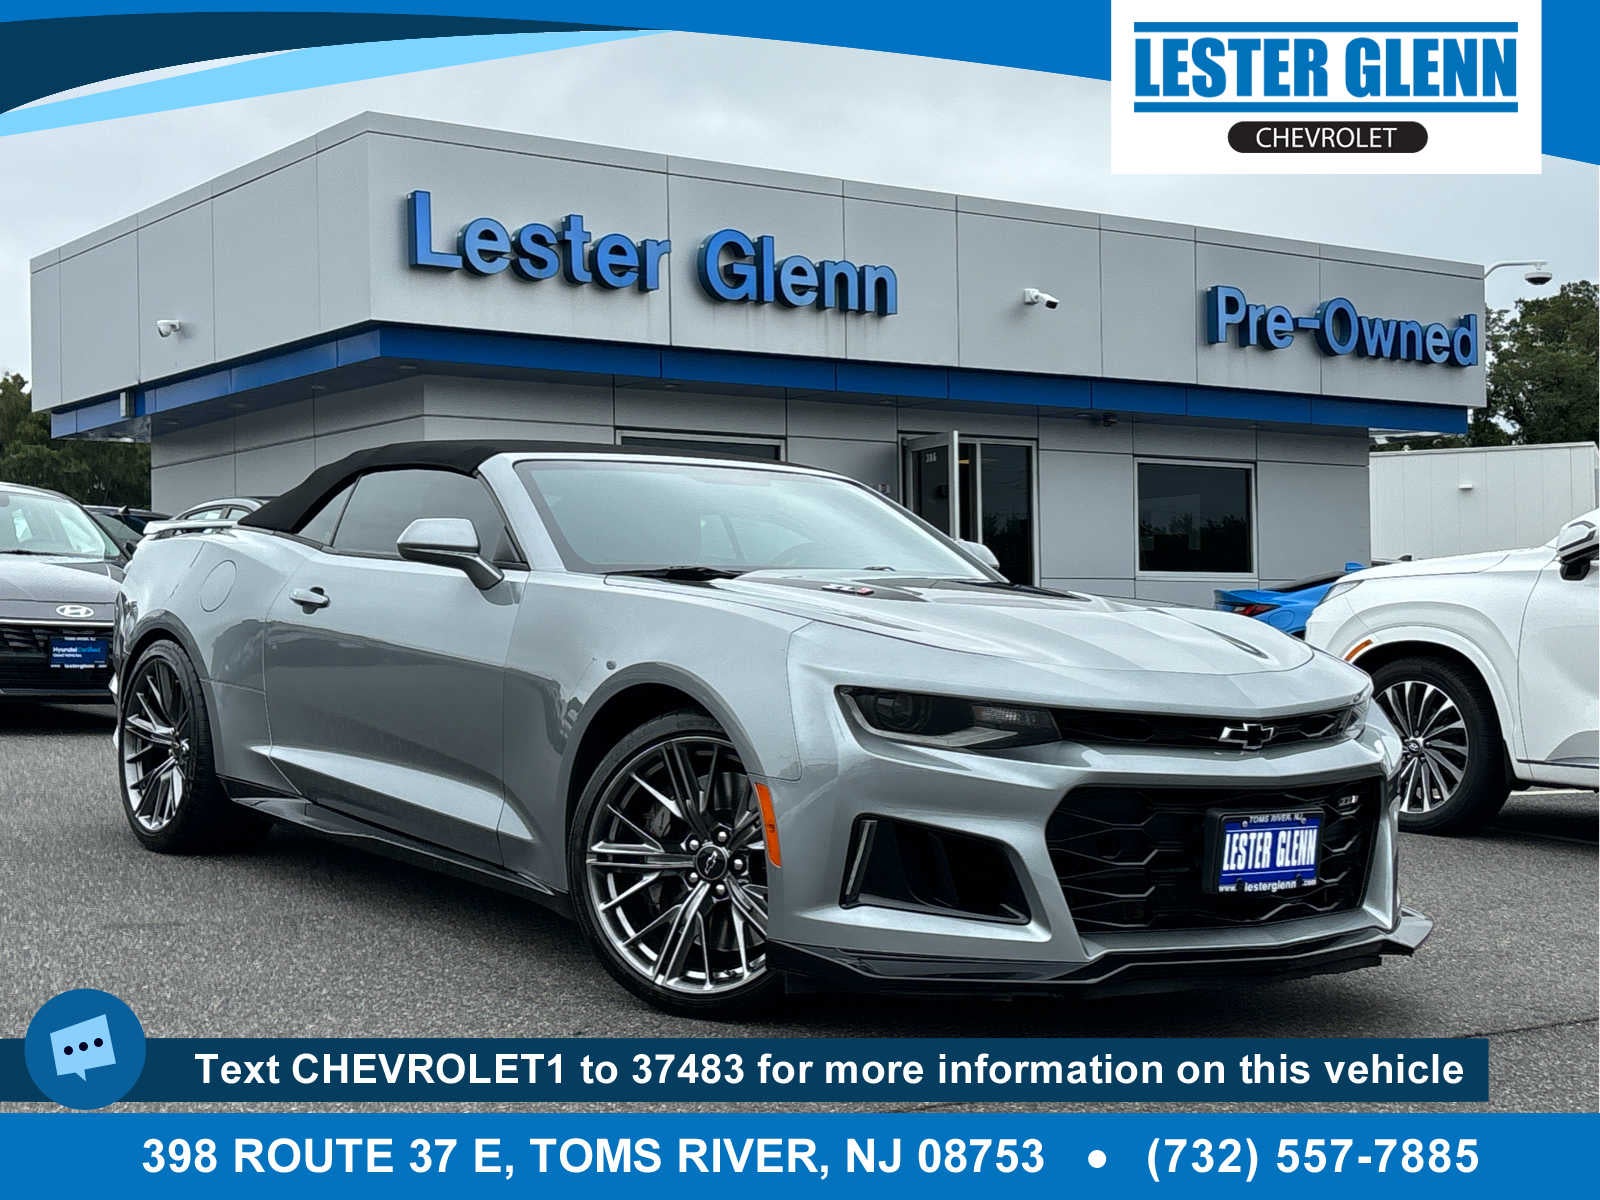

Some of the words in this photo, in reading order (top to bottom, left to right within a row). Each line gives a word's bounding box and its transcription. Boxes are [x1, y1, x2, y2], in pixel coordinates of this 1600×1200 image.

[407, 190, 671, 292] Lester
[698, 229, 898, 316] Glenn
[1207, 285, 1479, 367] Pre-Owned
[1222, 831, 1273, 871] LESTER
[1276, 828, 1318, 868] GLENN
[1244, 879, 1297, 893] lesterglenn
